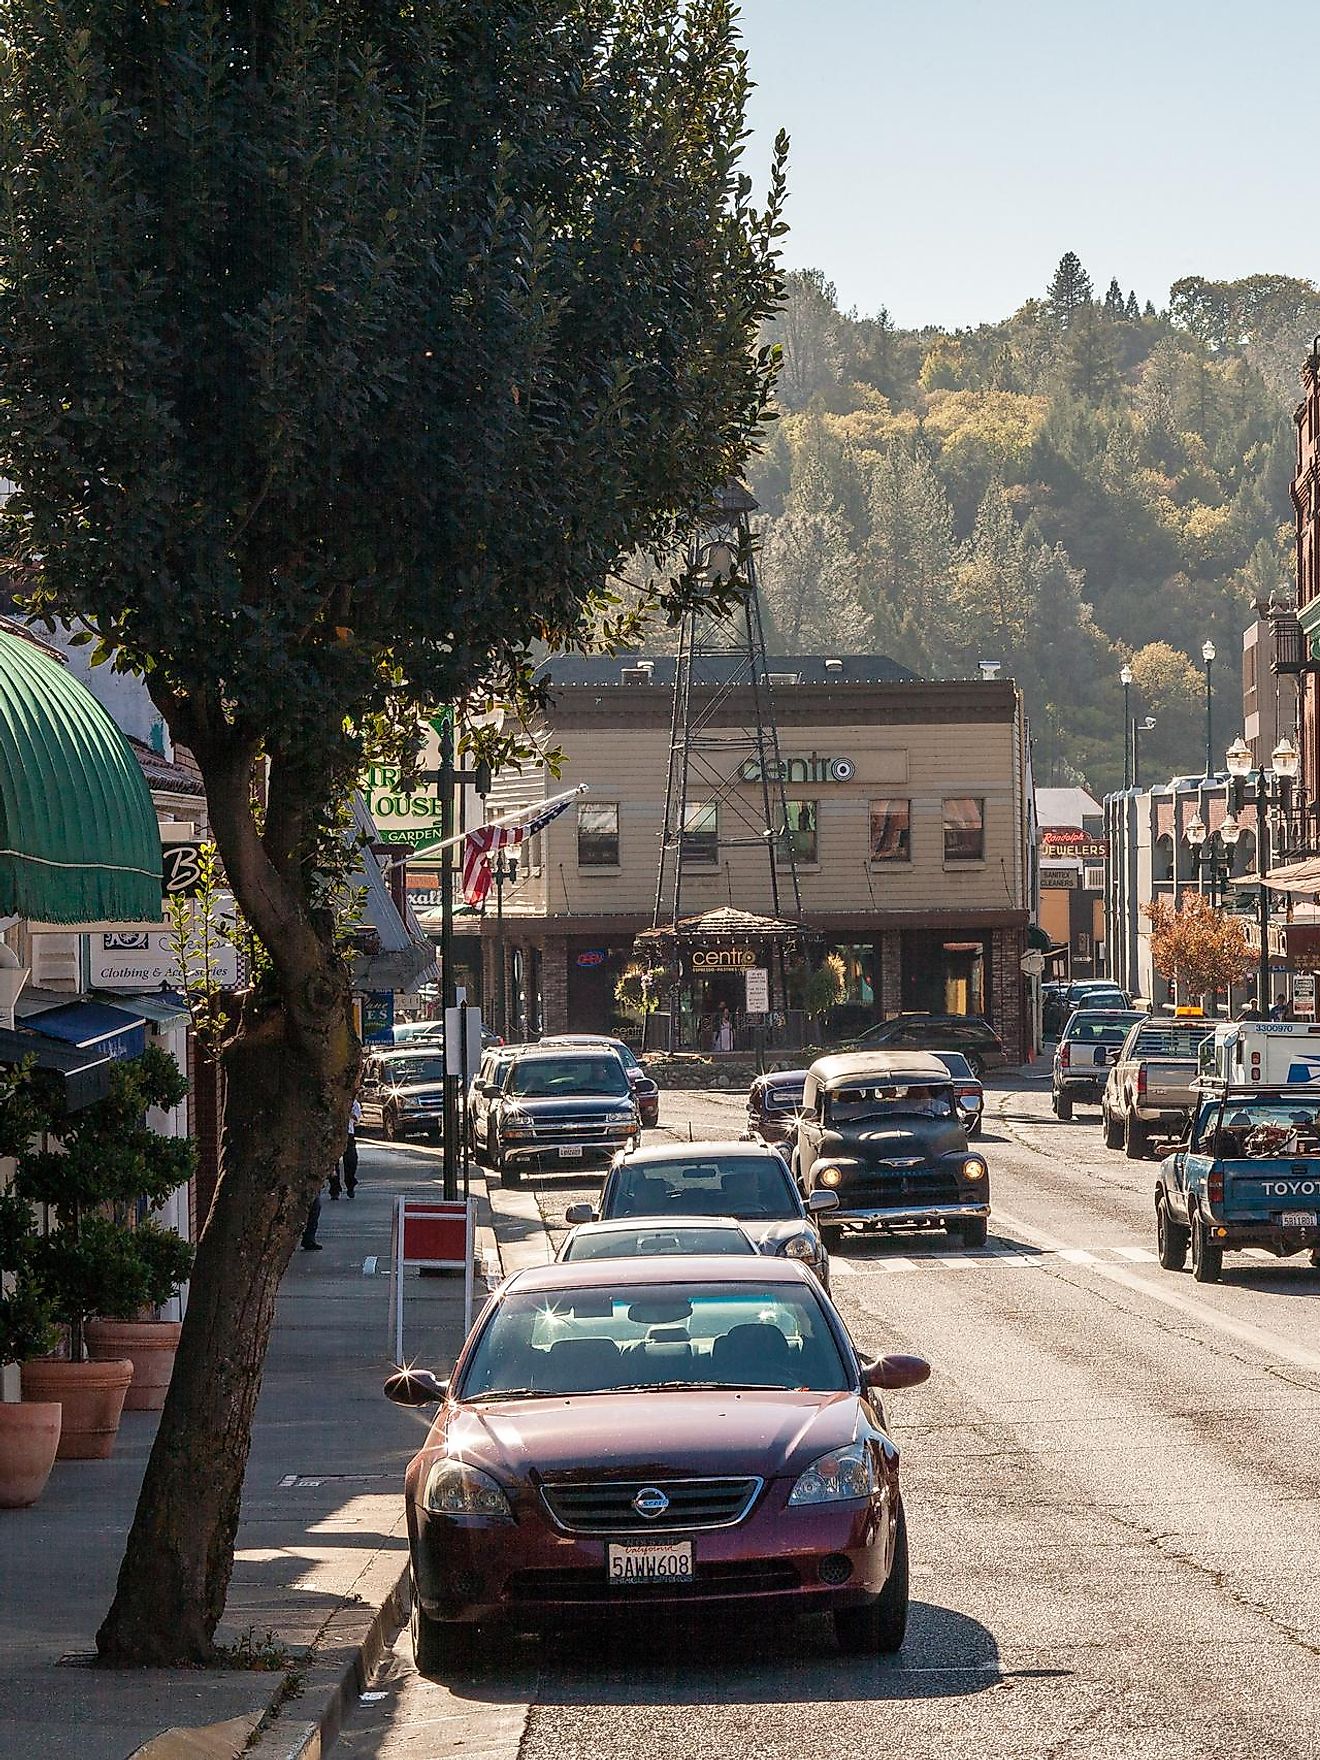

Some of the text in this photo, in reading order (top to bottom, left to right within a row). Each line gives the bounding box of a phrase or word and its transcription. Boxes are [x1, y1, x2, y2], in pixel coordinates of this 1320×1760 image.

[1043, 832, 1084, 844] Randolph
[1042, 845, 1106, 856] JEWELERS
[100, 967, 149, 980] Clothing
[152, 968, 162, 977] &
[611, 1026, 643, 1037] centr
[1255, 1024, 1293, 1033] 3300970
[613, 1555, 689, 1578] 5AWW608
